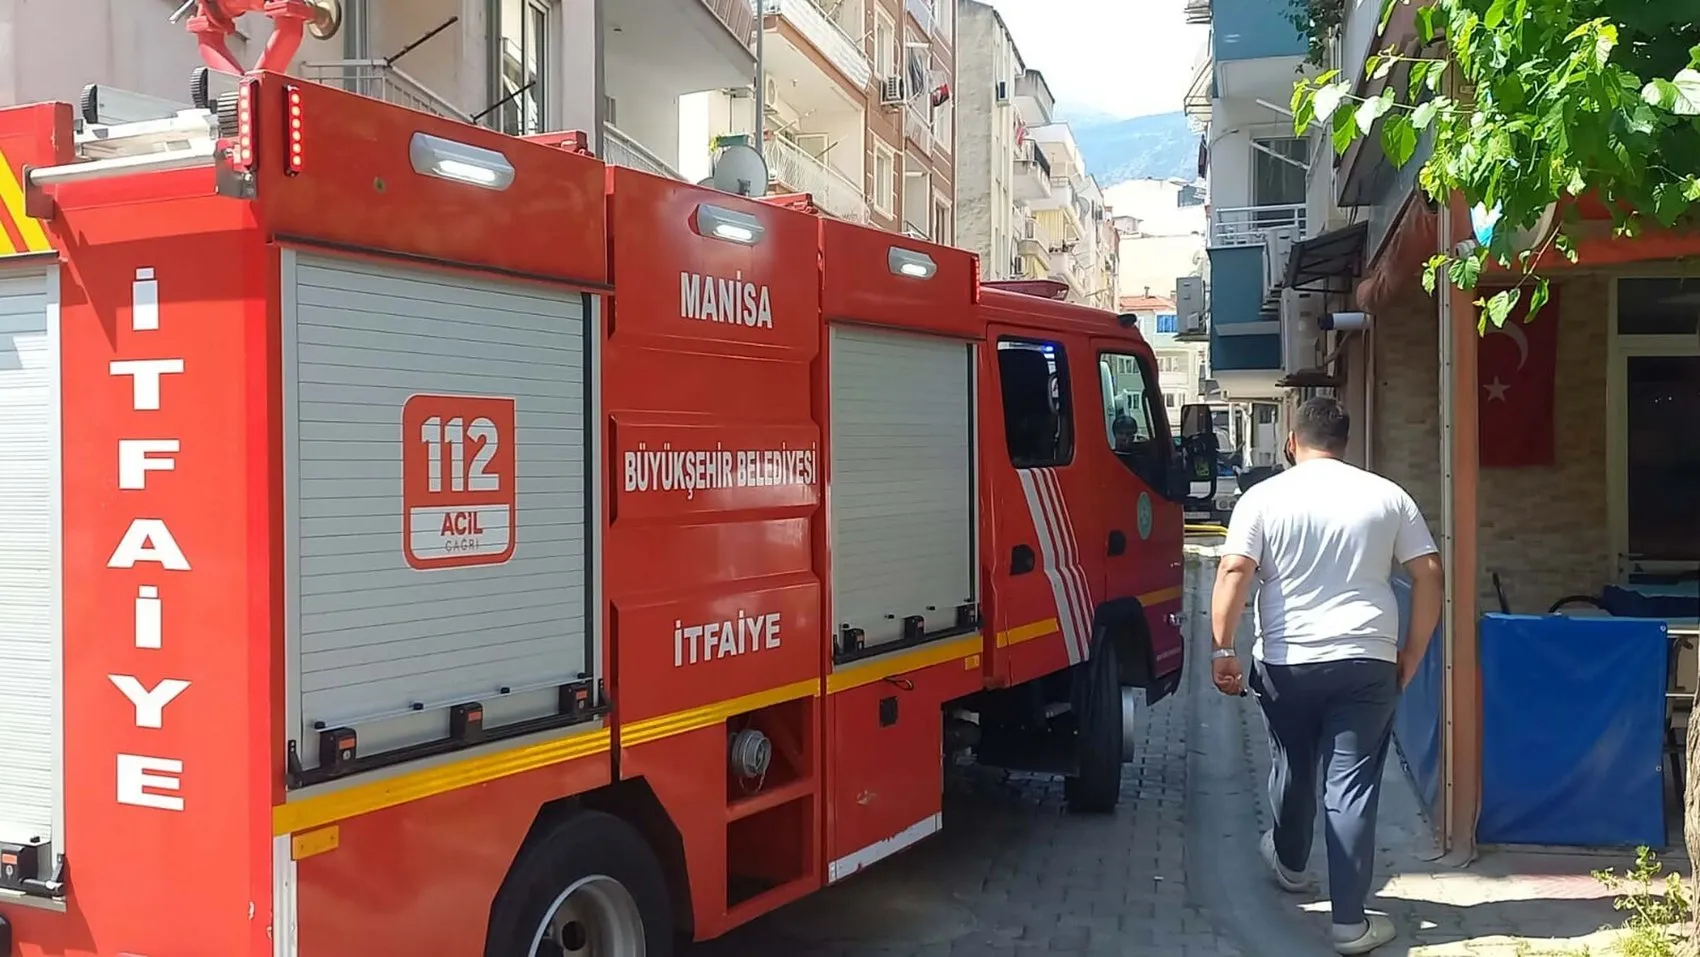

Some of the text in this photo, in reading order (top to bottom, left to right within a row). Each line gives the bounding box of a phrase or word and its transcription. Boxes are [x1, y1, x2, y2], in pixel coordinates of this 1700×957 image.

[680, 270, 773, 329] MANİSA
[421, 416, 500, 492] 112
[624, 442, 817, 500] BÜYÜKŞEHİR BELEDİYESİ
[106, 267, 192, 812] İTFAİYE
[673, 609, 781, 667] İTFAİYE
